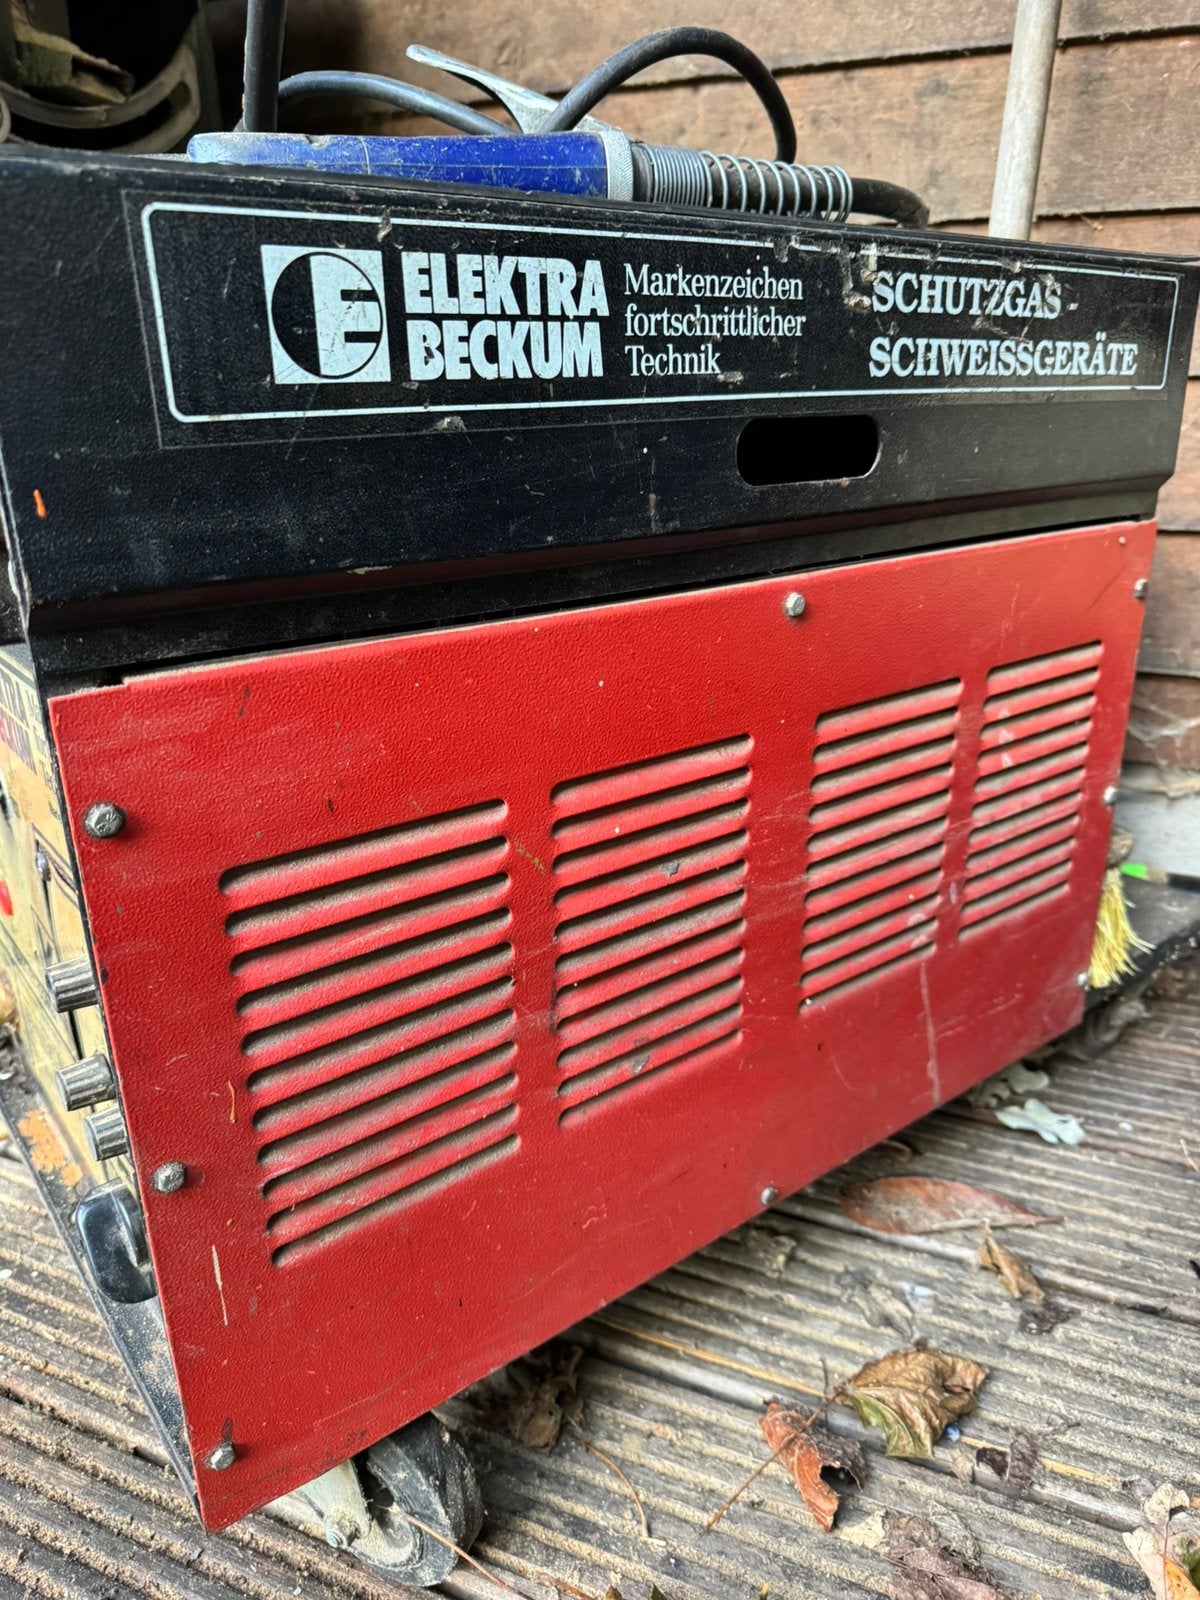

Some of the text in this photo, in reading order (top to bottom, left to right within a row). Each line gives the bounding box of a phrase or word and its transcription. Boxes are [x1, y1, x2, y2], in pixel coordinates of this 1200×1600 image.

[401, 251, 609, 317] ELEKTRA
[623, 263, 803, 300] Markenzeichen
[624, 302, 806, 337] fortschrittlicher
[406, 319, 604, 381] BECKUM
[624, 343, 722, 377] Technik
[868, 331, 1139, 378] SCHWEISSGERÄTE
